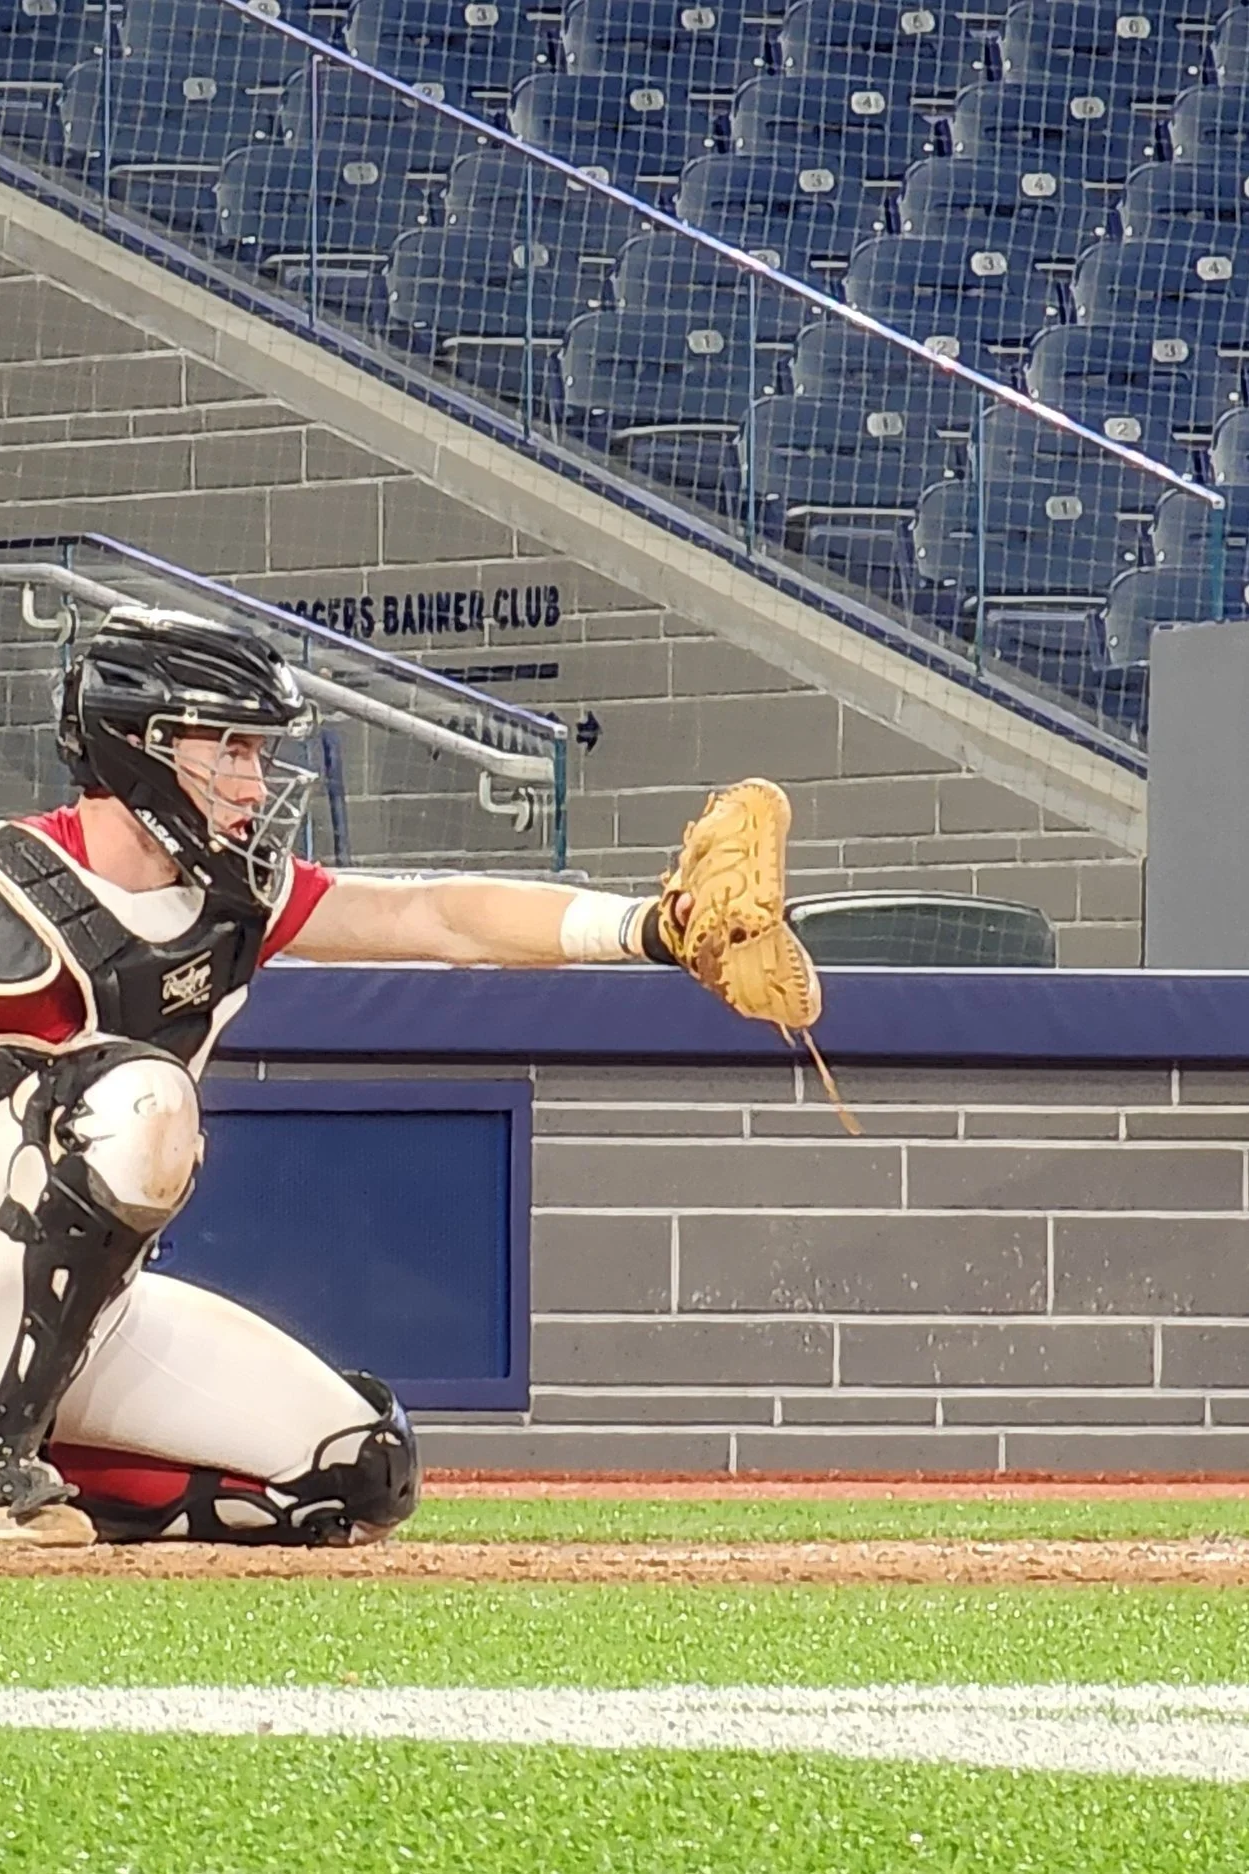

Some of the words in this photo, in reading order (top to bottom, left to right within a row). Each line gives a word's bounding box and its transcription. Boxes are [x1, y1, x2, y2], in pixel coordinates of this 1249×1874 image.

[477, 7, 488, 22] 3
[1129, 19, 1140, 34] 6
[1034, 176, 1044, 191] 4
[983, 256, 994, 271] 3
[1209, 261, 1220, 275] 4
[936, 340, 947, 355] 2
[1164, 343, 1176, 358] 3
[1116, 422, 1129, 437] 2
[1061, 500, 1069, 515] 1
[382, 589, 486, 636] BANNER
[492, 584, 561, 628] CLUB
